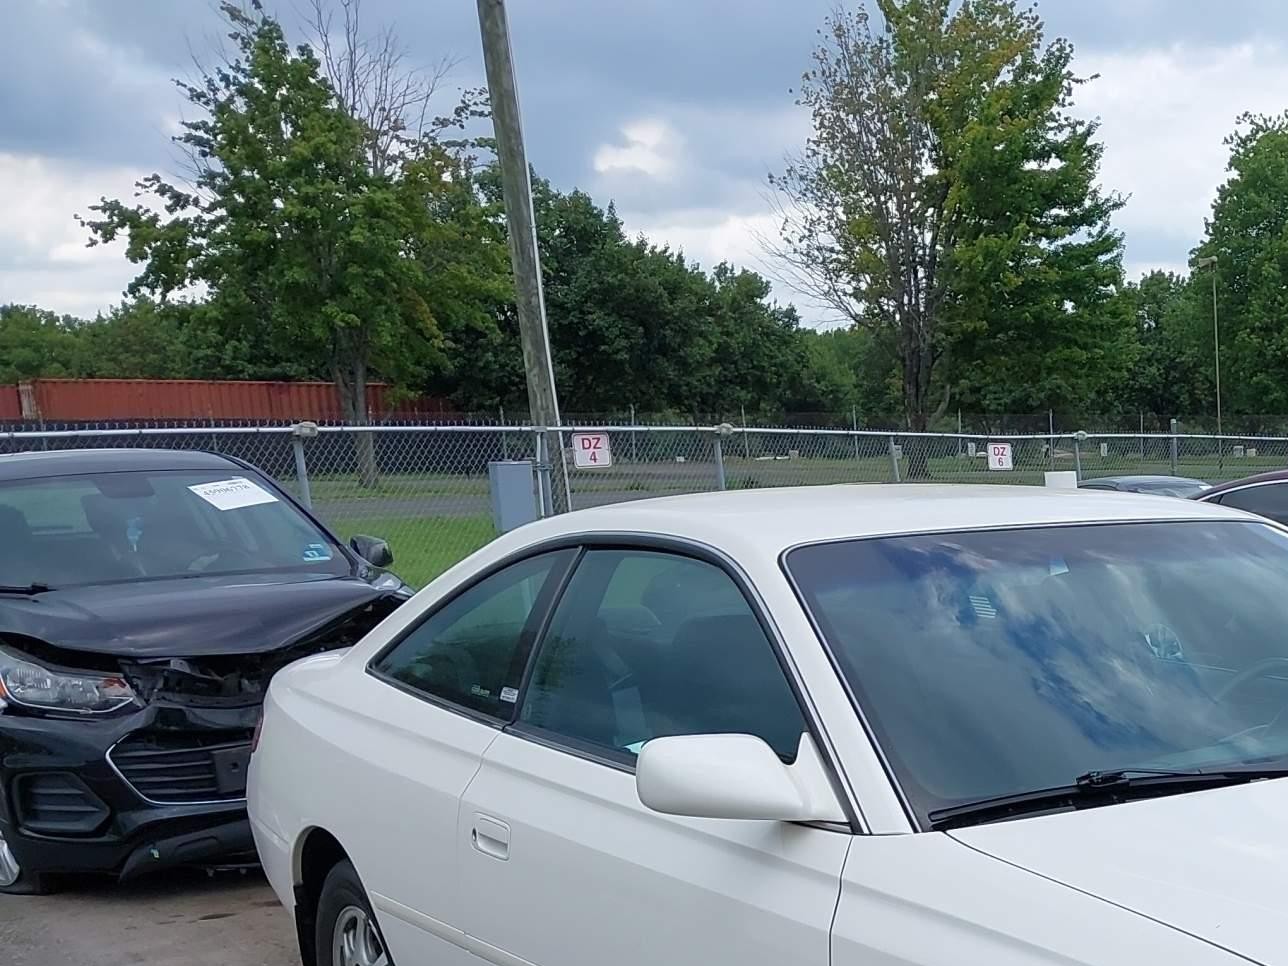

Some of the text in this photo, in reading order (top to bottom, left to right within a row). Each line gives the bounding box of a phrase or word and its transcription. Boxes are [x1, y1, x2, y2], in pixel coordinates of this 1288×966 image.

[581, 437, 602, 450] DZ
[589, 451, 598, 463] 4
[993, 446, 1006, 457] DZ
[998, 457, 1004, 466] 6
